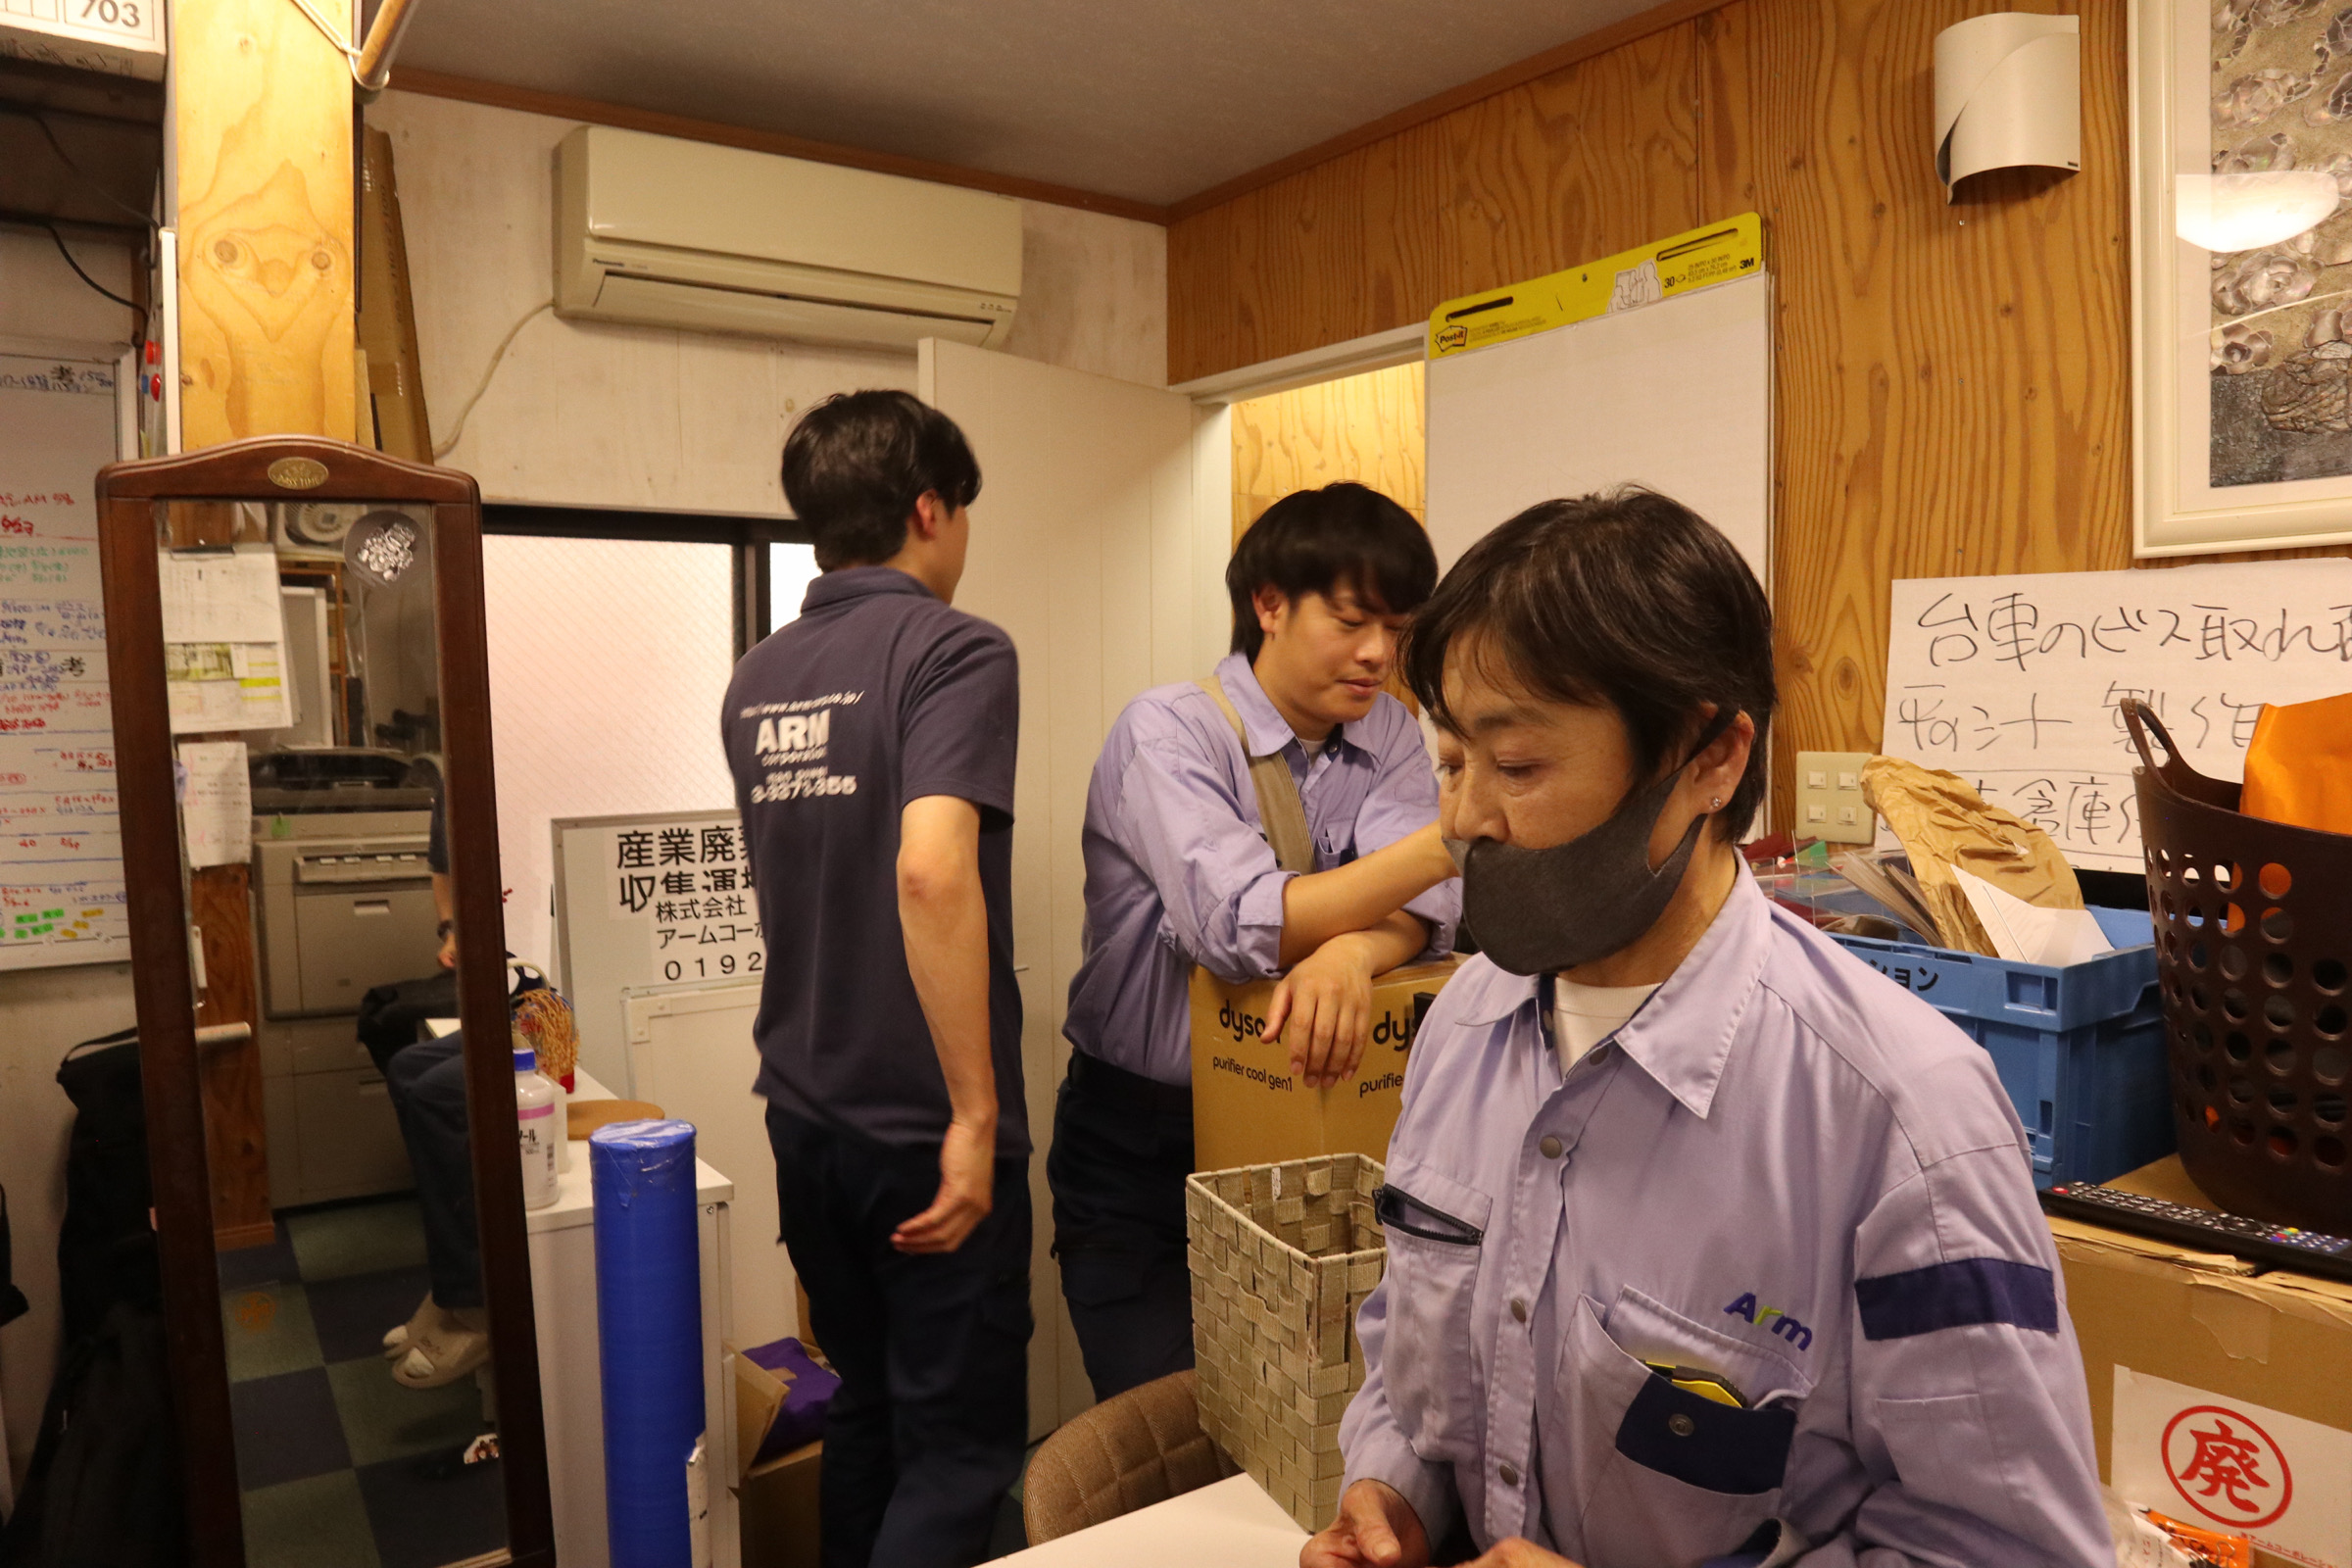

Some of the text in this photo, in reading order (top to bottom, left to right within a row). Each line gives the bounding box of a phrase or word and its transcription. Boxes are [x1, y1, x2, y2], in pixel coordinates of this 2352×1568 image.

[1664, 276, 1675, 288] 30
[1740, 258, 1754, 270] 3M
[755, 708, 831, 756] ARM
[656, 894, 748, 924] 株式会社
[664, 952, 763, 981] 0192
[1218, 999, 1282, 1045] dyso
[1373, 1010, 1418, 1052] dy
[1212, 1055, 1294, 1093] purifier cool gen1
[1359, 1072, 1405, 1098] purifie
[1723, 1292, 1813, 1352] Arm
[2178, 1418, 2271, 1514] 廃
